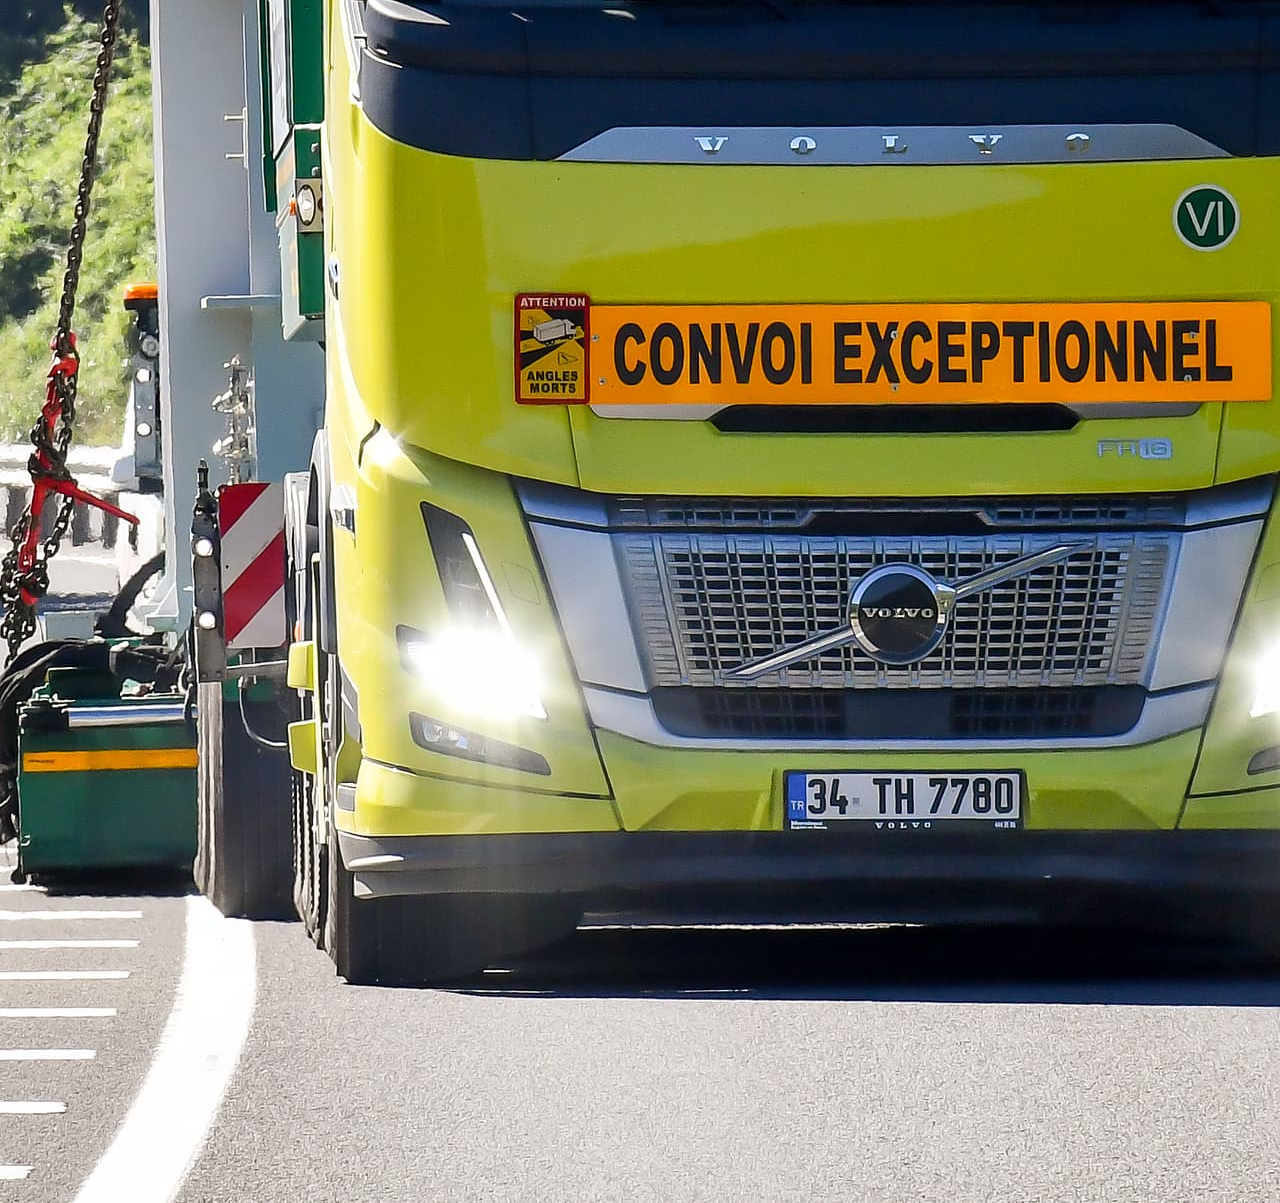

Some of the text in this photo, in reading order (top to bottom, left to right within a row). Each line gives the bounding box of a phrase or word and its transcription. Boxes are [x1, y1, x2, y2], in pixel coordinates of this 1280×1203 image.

[694, 133, 1090, 156] VOLVO
[1185, 201, 1224, 236] VI
[520, 297, 586, 307] ATTENTION
[613, 319, 1233, 386] CONVOI EXCEPTIONNEL
[527, 371, 578, 382] ANGLES
[529, 383, 576, 394] MORTS
[862, 608, 934, 618] VOLVO
[808, 777, 1013, 815] 34 TH 7780
[790, 800, 804, 811] TR
[875, 821, 931, 829] VOLVO
